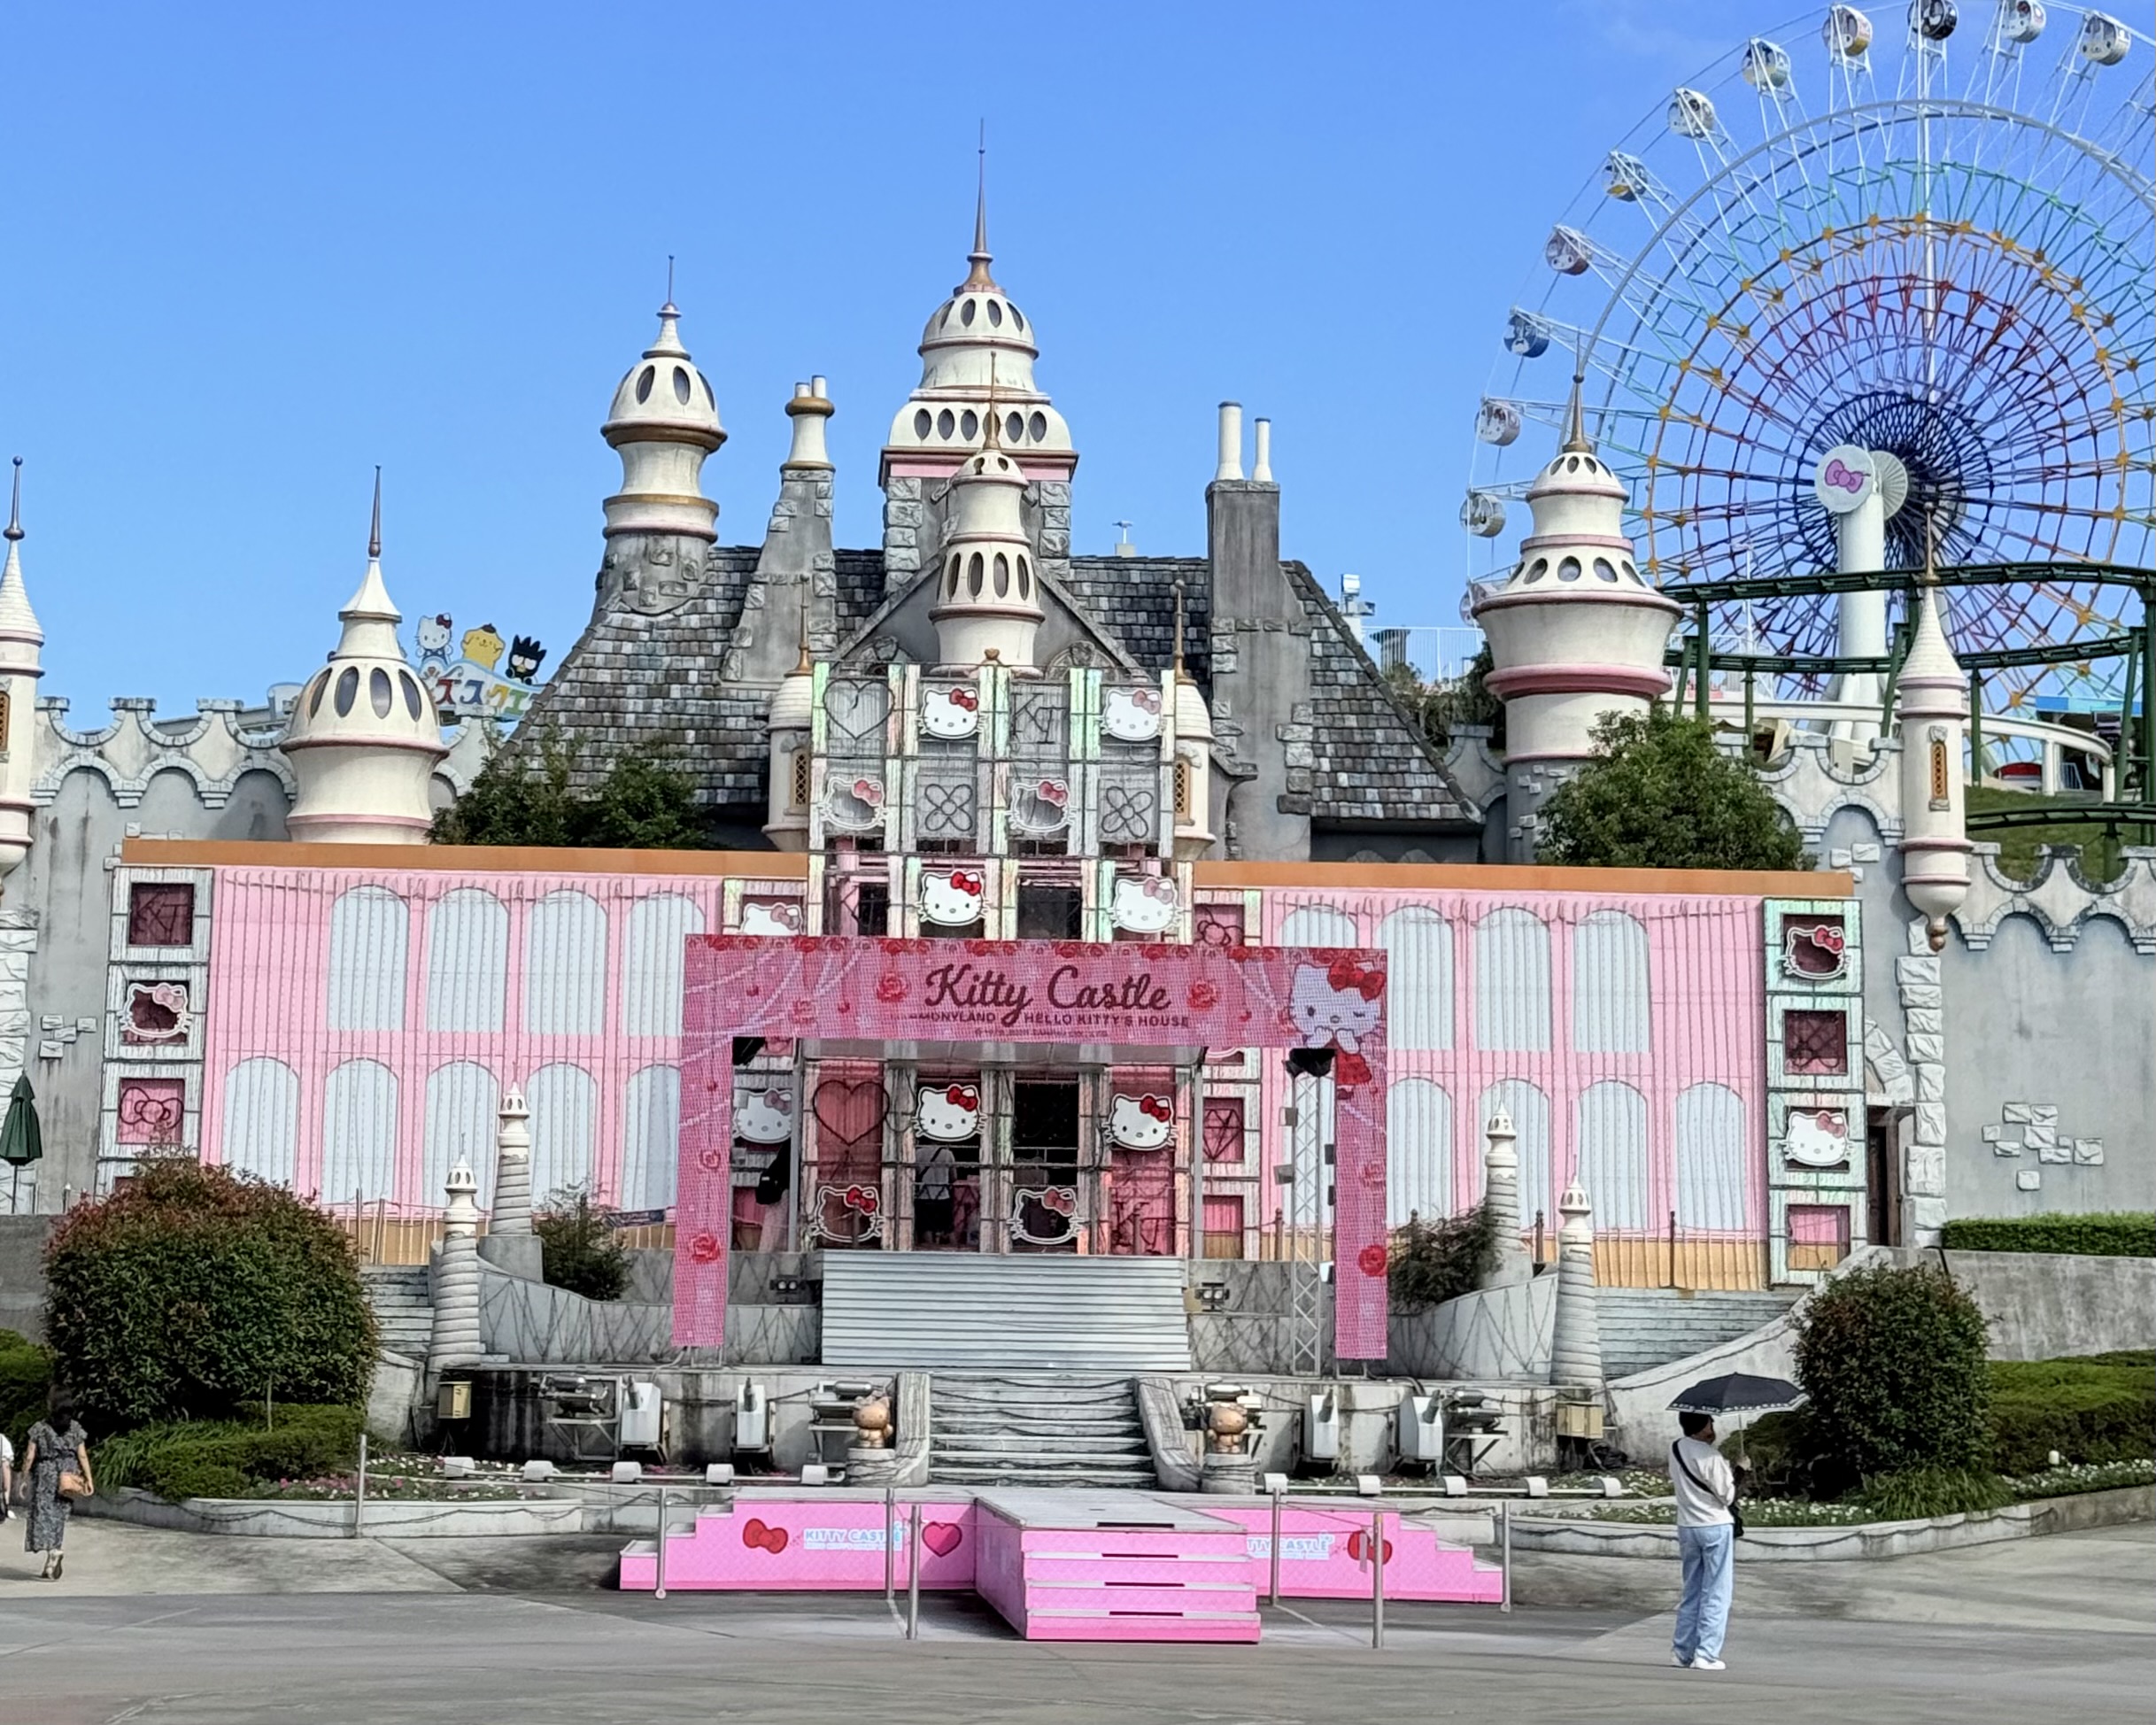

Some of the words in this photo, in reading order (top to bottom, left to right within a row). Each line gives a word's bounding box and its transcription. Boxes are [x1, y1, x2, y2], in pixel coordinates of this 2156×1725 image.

[434, 678, 529, 716] ズスクエ
[924, 963, 1034, 1027] Kitty
[1047, 964, 1171, 1010] Castle
[1024, 1013, 1072, 1025] HELLO
[1139, 1016, 1189, 1029] HOUSE
[806, 1530, 845, 1541] KITTY
[850, 1531, 900, 1542] CASTE
[1247, 1538, 1271, 1550] TTY
[1280, 1539, 1328, 1551] ASTLE
